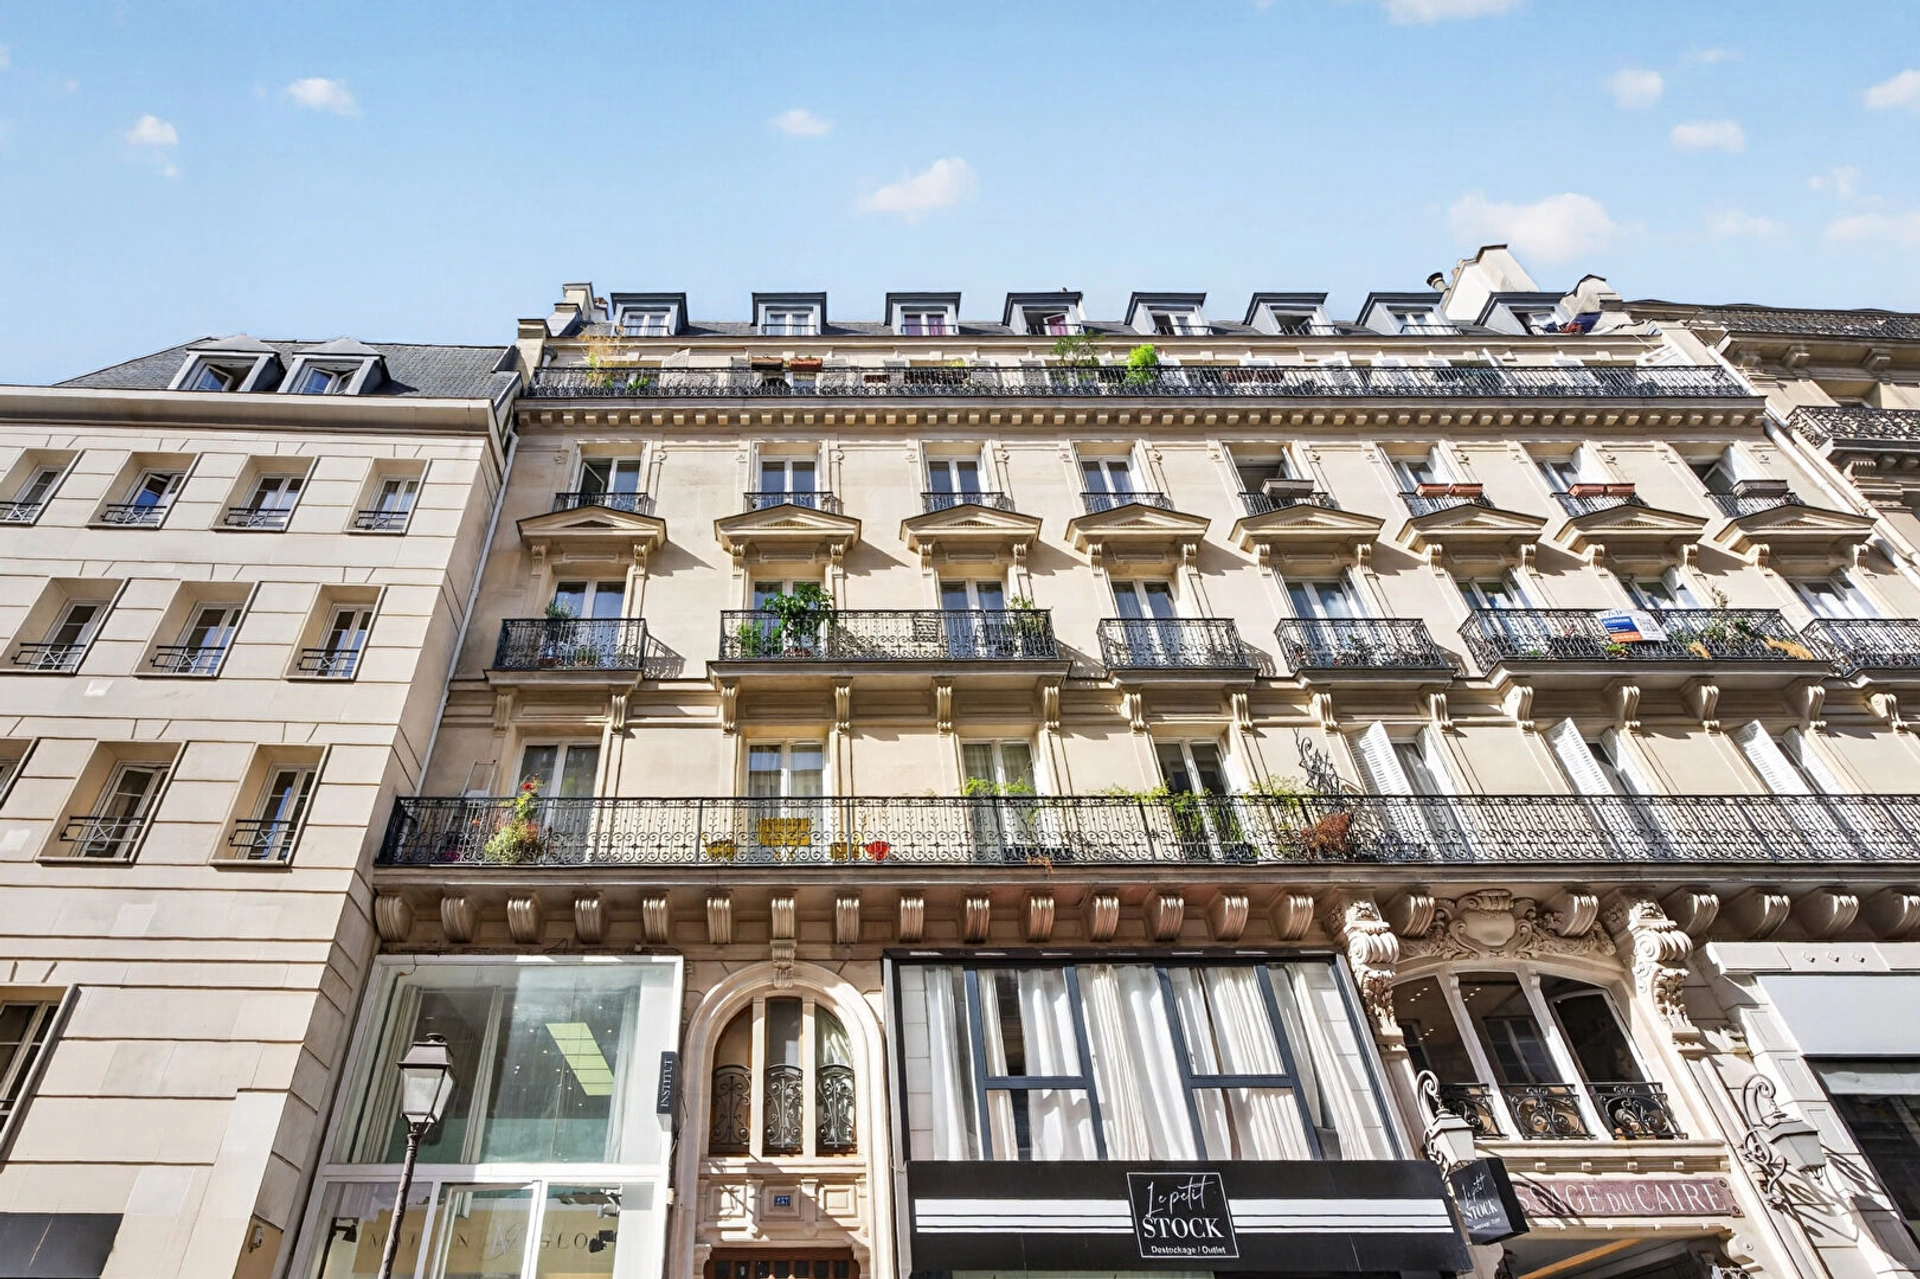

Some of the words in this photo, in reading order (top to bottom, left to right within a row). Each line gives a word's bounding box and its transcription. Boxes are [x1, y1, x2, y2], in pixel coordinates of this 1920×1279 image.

[660, 1058, 673, 1108] INSTITUT
[1145, 1181, 1167, 1219] Le
[1169, 1174, 1215, 1215] petit
[1465, 1199, 1498, 1221] STOCK
[1606, 1191, 1636, 1213] DU
[1634, 1182, 1728, 1212] CAIRE
[1142, 1216, 1226, 1239] STOCK
[1150, 1245, 1197, 1256] Destockage
[1201, 1245, 1227, 1255] Outlet
